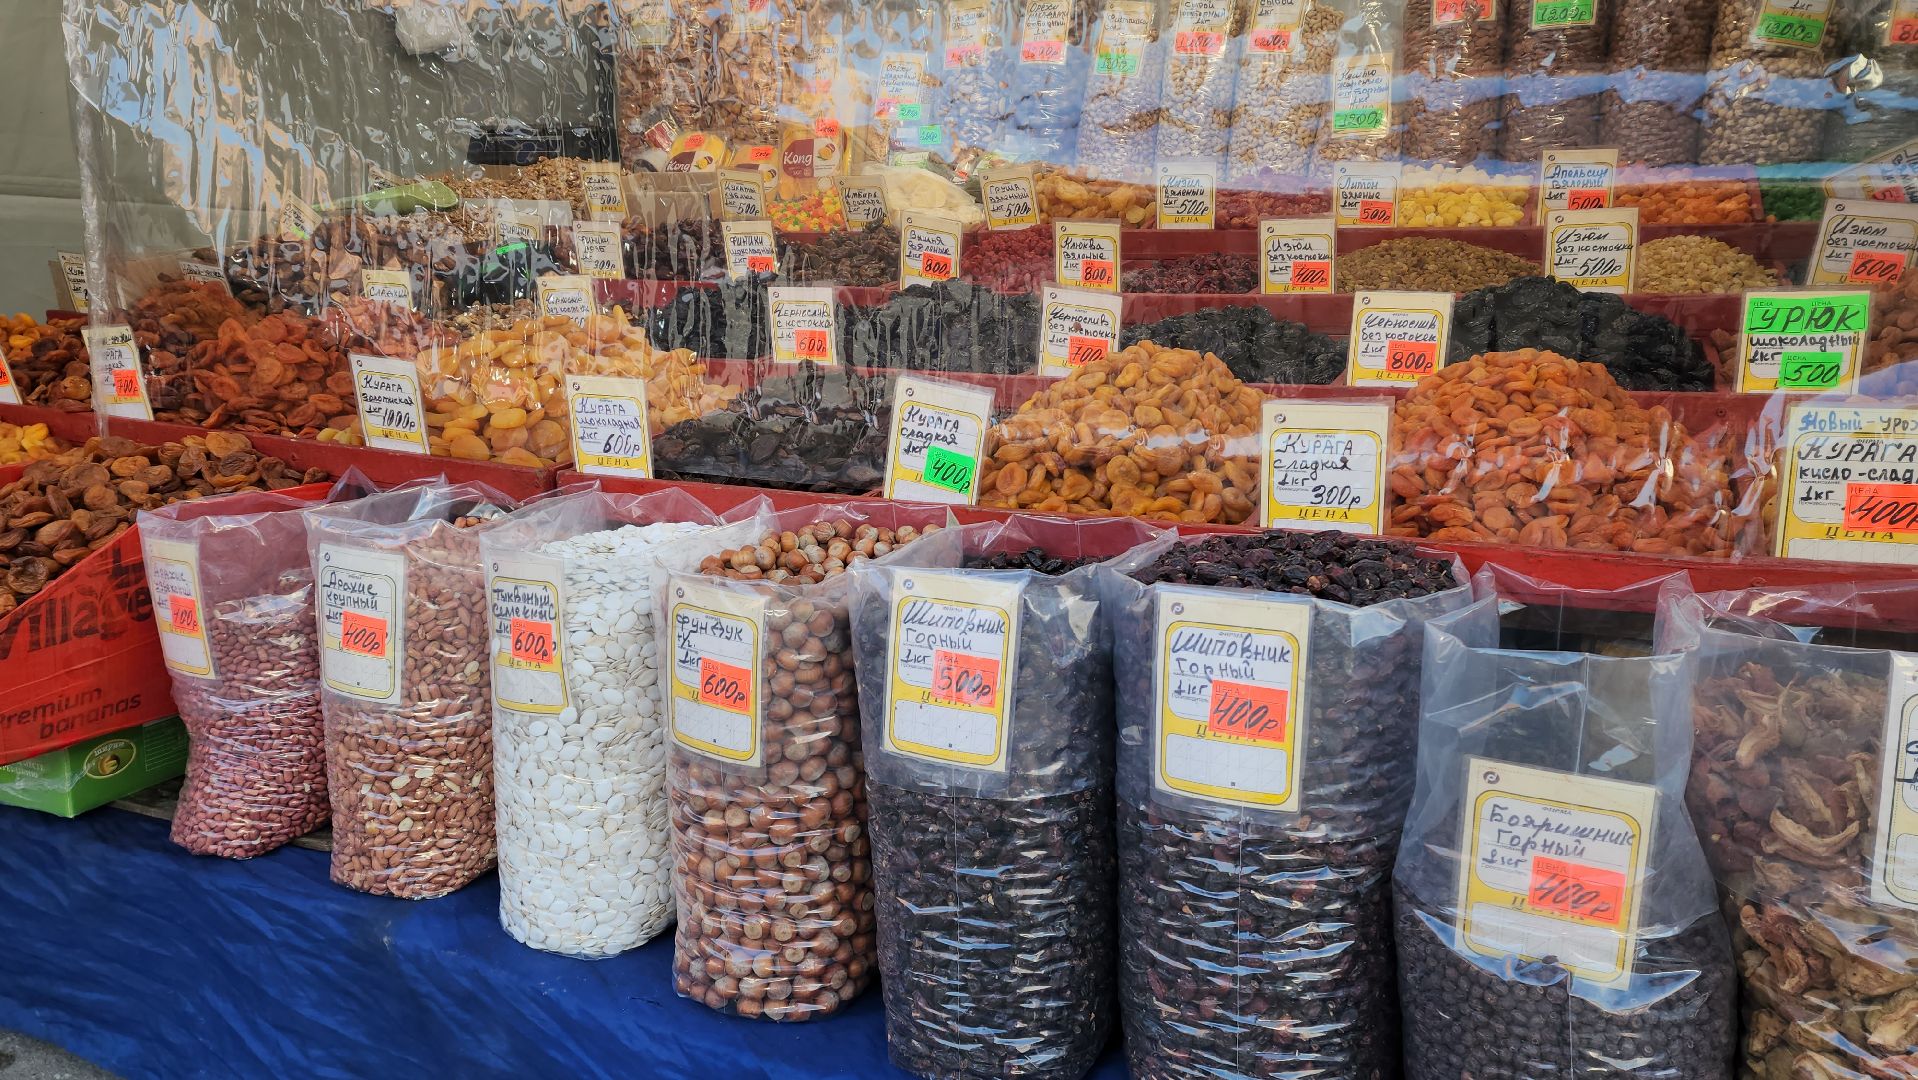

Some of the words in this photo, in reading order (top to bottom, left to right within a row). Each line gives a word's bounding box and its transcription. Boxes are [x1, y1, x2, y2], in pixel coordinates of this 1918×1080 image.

[1176, 199, 1209, 216] 500р
[1361, 208, 1391, 223] 500р
[1083, 266, 1113, 285] 800р
[1574, 256, 1623, 277] 500р
[1747, 305, 1861, 333] УРЮК
[1391, 351, 1434, 373] 800р
[1784, 363, 1841, 384] 500
[382, 407, 416, 432] 1000р
[1797, 411, 1863, 432] Новый
[932, 457, 972, 494] 400р
[1309, 484, 1362, 512] 300р
[1800, 485, 1836, 502] 1кг
[1298, 508, 1350, 520] ЦЕНА
[903, 599, 1007, 636] Шиповник
[344, 621, 381, 653] 400р
[513, 630, 549, 662] 600р
[1171, 631, 1292, 664] Шиповник
[900, 648, 931, 664] 1кг
[703, 672, 746, 705] 600р
[937, 666, 992, 702] 500р
[1173, 683, 1209, 696] 1кг
[0, 686, 103, 731] remium
[39, 692, 142, 740] bananas
[1212, 691, 1280, 734] 400р
[1534, 872, 1613, 917] 400р
